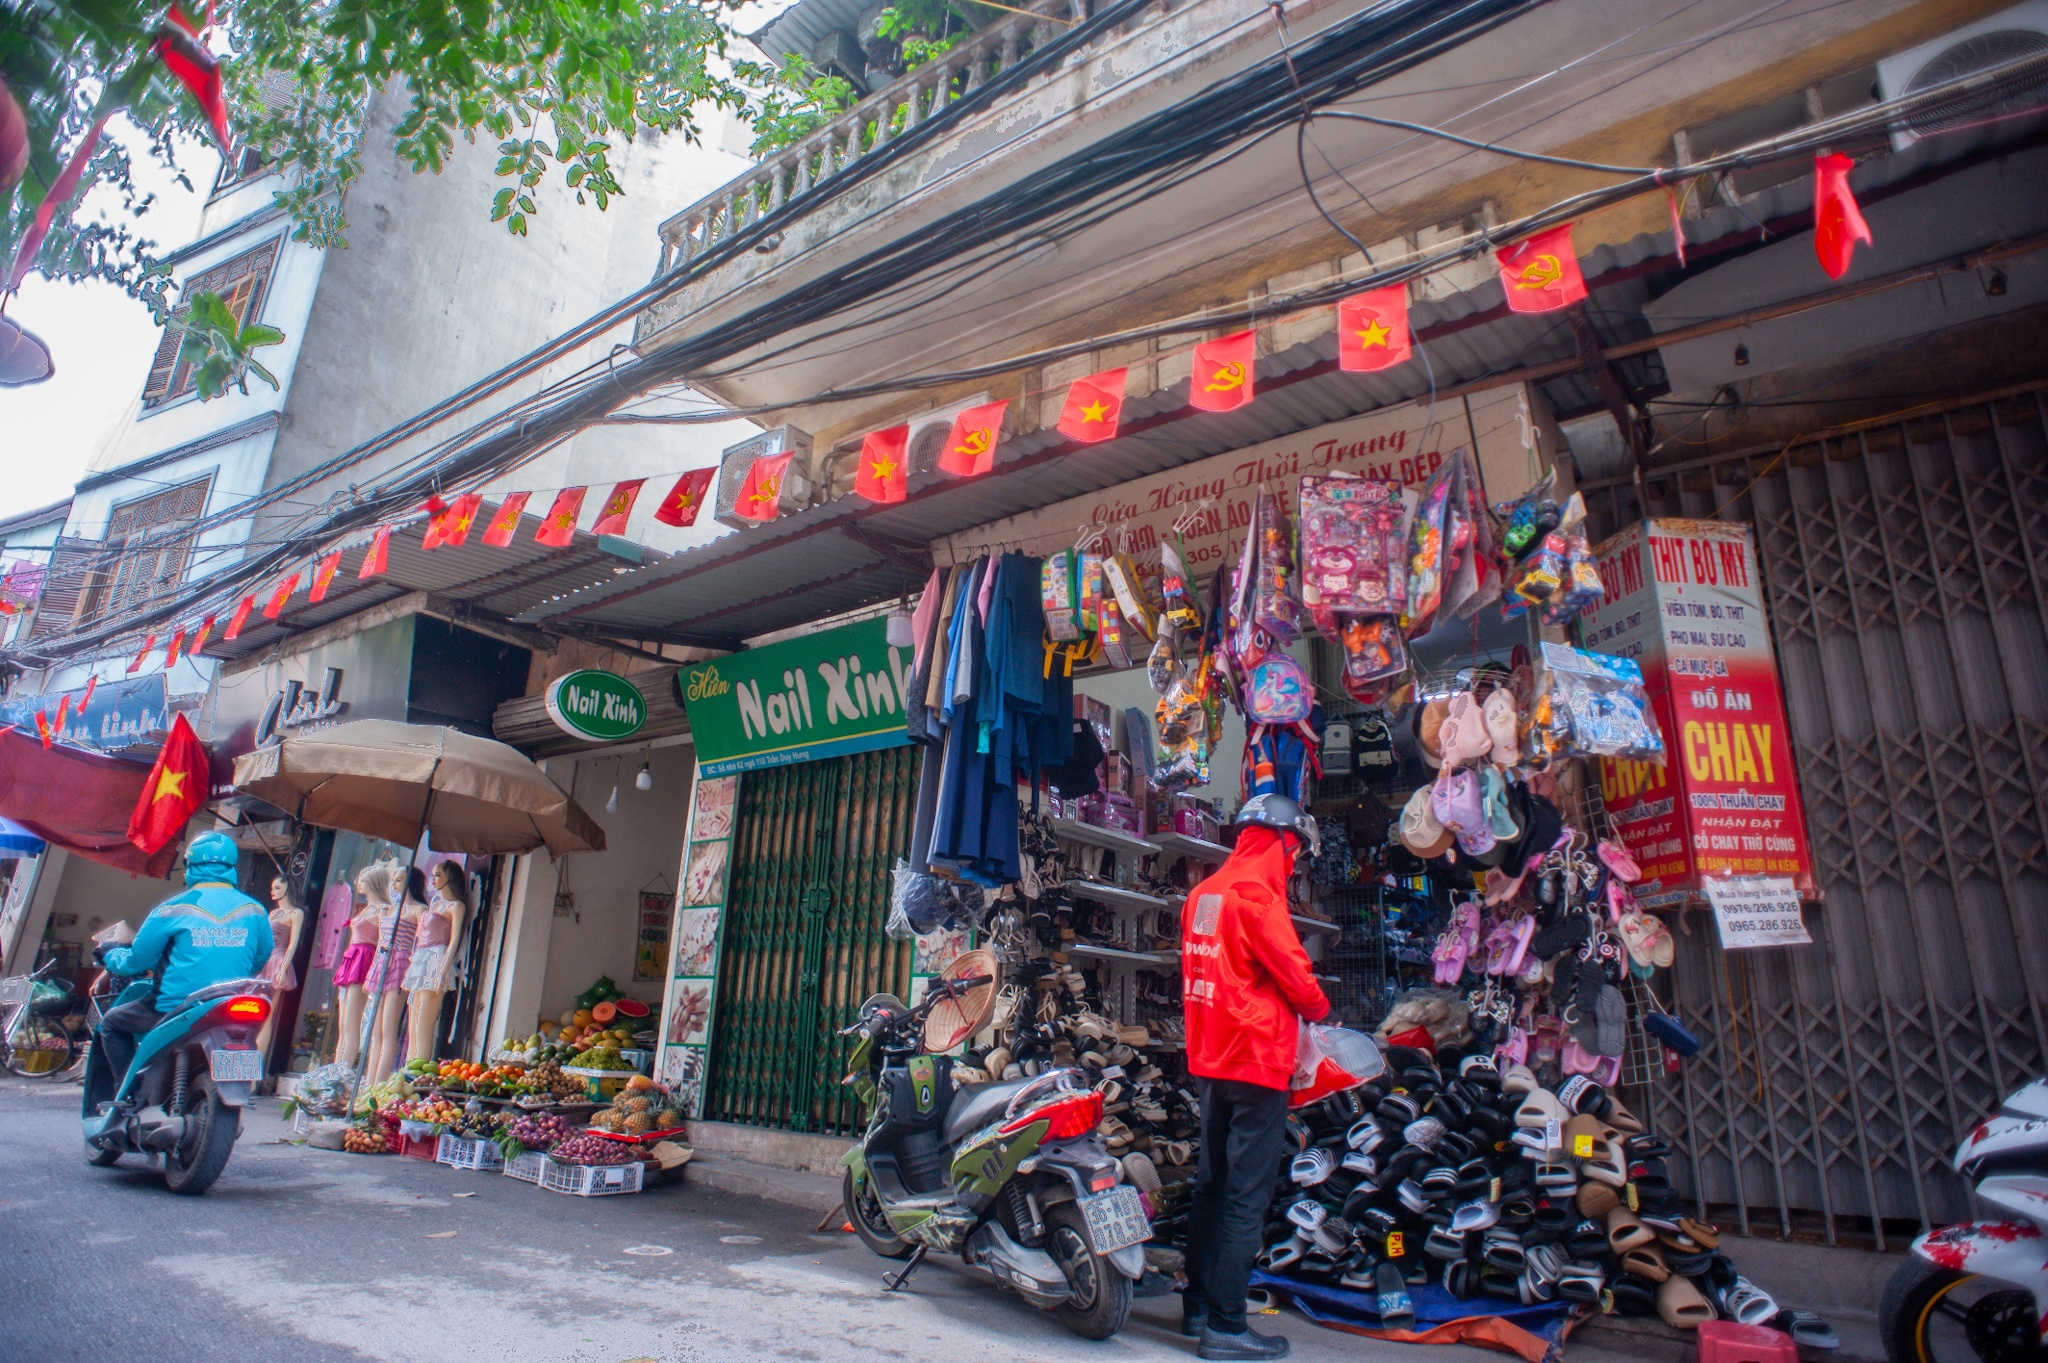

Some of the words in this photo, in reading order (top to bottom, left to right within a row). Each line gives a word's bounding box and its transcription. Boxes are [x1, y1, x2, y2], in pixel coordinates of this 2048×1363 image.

[1148, 475, 1225, 513] Hàng
[1234, 452, 1299, 488] Thời
[1312, 429, 1406, 466] Trang
[1227, 499, 1251, 530] ÁO
[1187, 544, 1222, 564] 305
[1648, 535, 1689, 594] THỊT
[1689, 528, 1718, 586] BÒ
[1670, 630, 1689, 645] PHO
[567, 684, 600, 716] Nail
[602, 692, 637, 726] Xinh
[736, 666, 812, 740] Nail
[1691, 686, 1719, 709] ĐỒ
[1724, 689, 1752, 711] ĂN
[736, 761, 744, 769] 62
[755, 757, 766, 766] 110
[780, 753, 792, 763] Duy
[1684, 720, 1775, 783] CHAY
[1690, 793, 1719, 808] 100%
[1719, 788, 1756, 810] THUẦN
[1757, 795, 1785, 811] CHAY
[1701, 816, 1746, 829] NHẬN
[1750, 817, 1783, 830] ĐẶT
[1711, 834, 1739, 850] CHAY
[1742, 832, 1763, 851] THỜ
[1766, 833, 1796, 852] CÚNG
[1717, 889, 1736, 899] Mua
[1723, 901, 1798, 914] 0976.286.926
[1729, 919, 1801, 932] 0965.286.926
